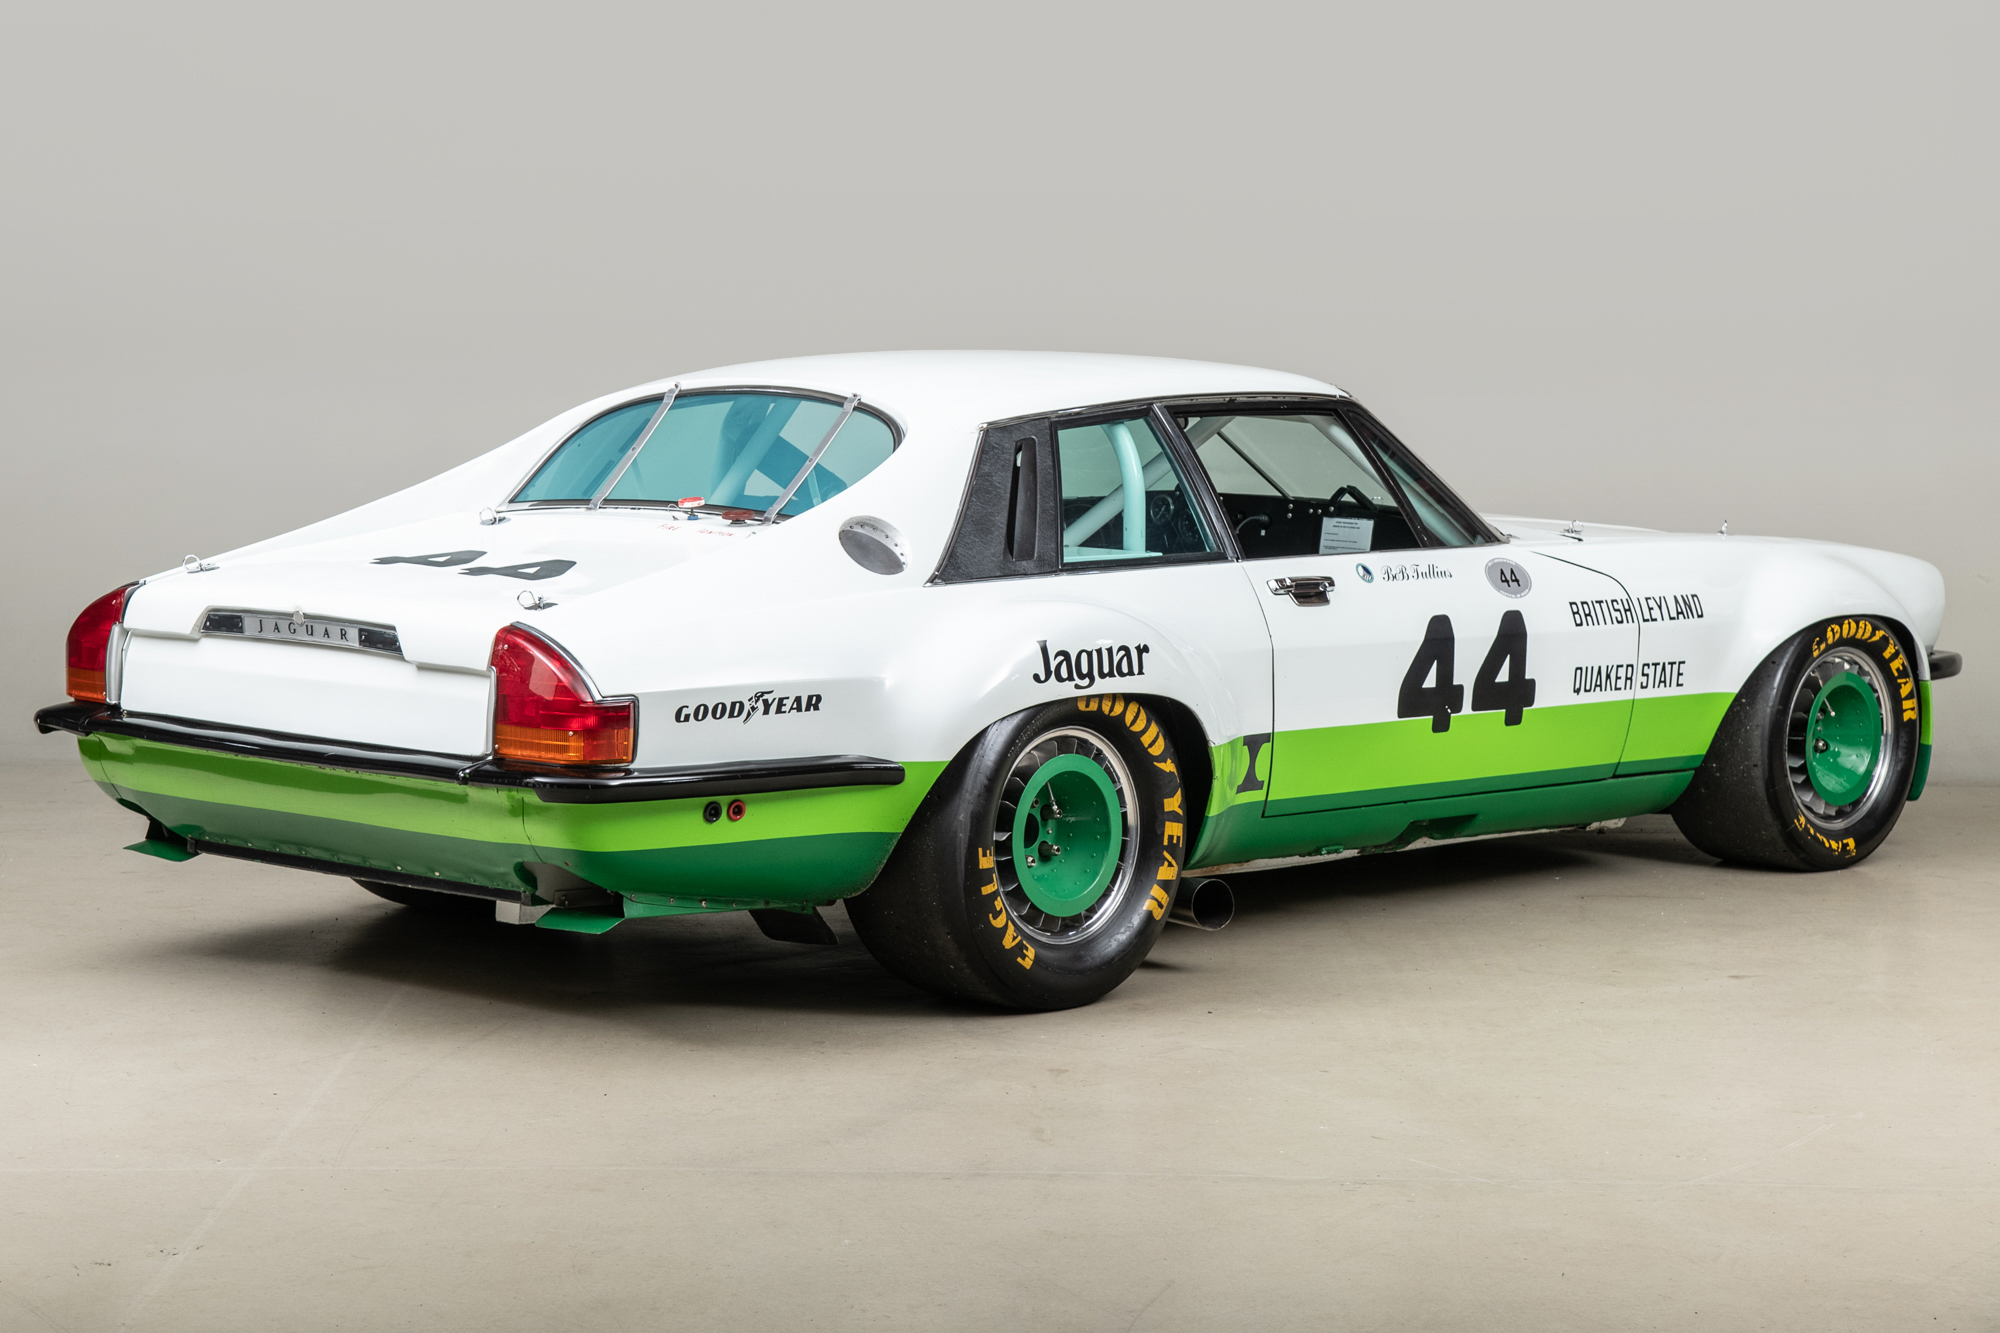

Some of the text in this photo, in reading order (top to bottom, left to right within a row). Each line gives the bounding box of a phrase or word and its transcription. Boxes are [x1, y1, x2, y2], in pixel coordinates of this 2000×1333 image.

[369, 549, 577, 581] 44
[1500, 567, 1521, 588] 44
[1568, 593, 1705, 627] BRITISH LEYLAND
[258, 619, 349, 642] JAGUAR
[1032, 639, 1150, 690] Jaguar
[1397, 609, 1537, 734] 44
[1573, 660, 1686, 696] QUAKER STATE
[978, 846, 1037, 970] EAGLE
